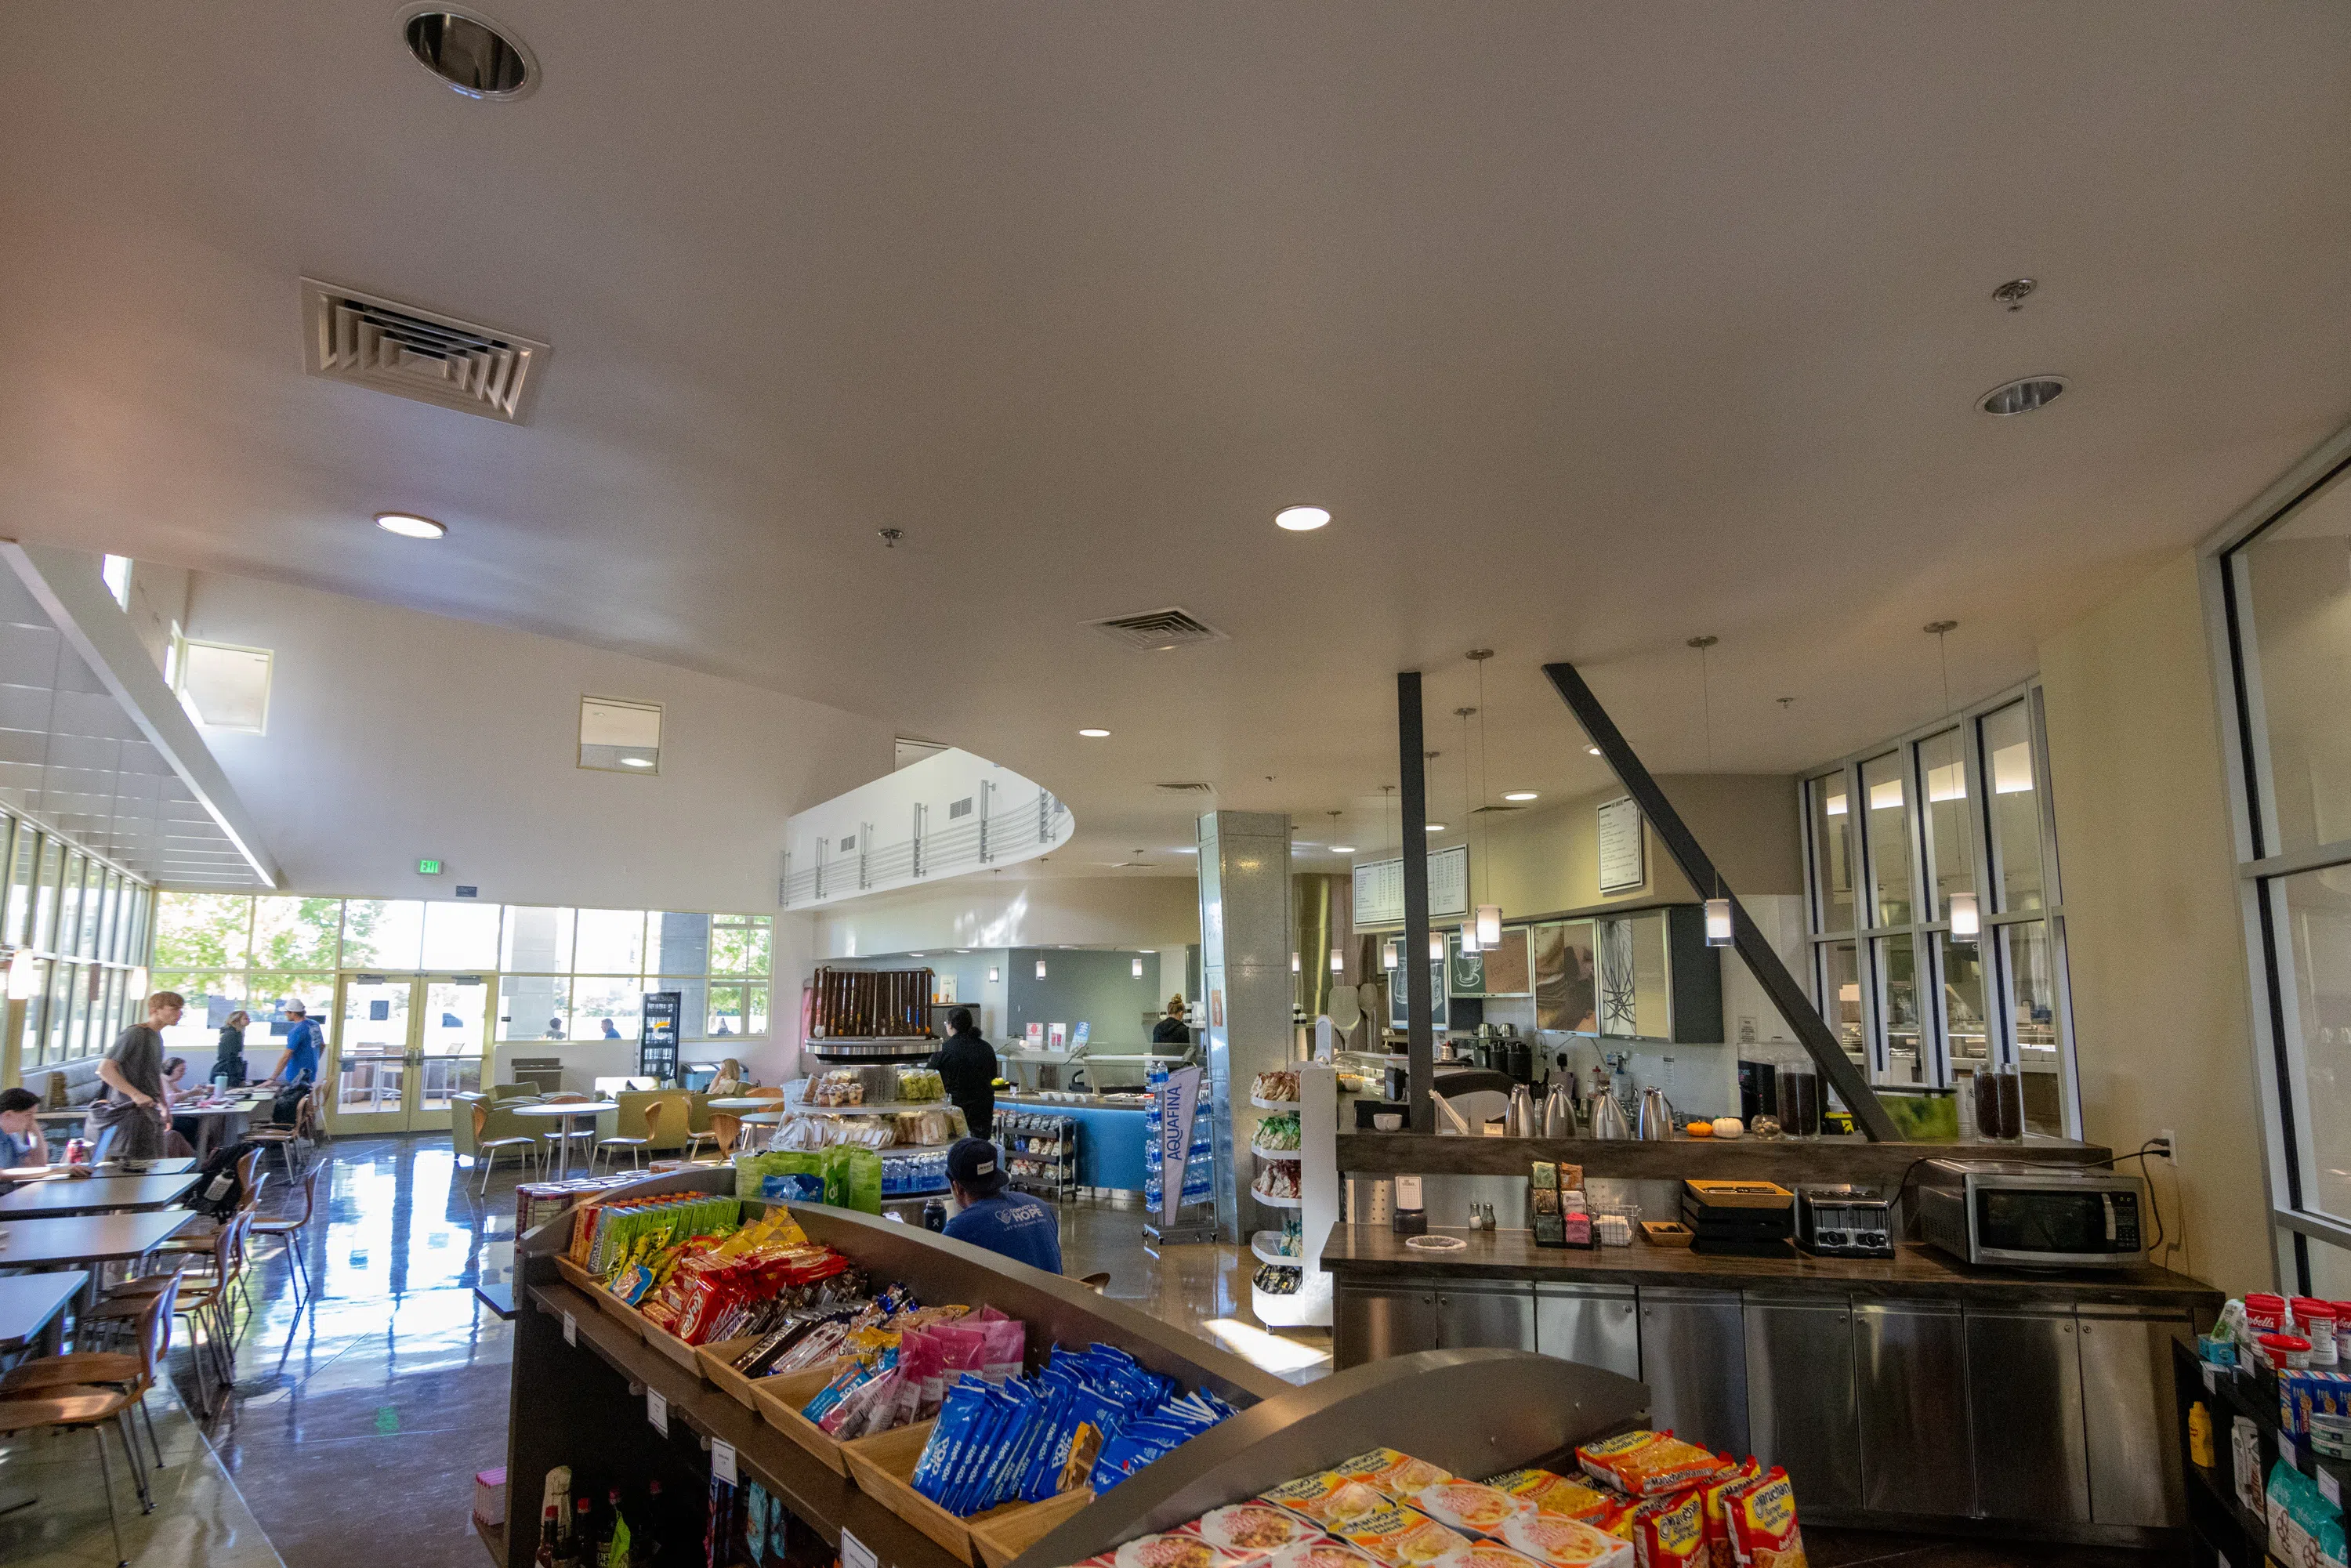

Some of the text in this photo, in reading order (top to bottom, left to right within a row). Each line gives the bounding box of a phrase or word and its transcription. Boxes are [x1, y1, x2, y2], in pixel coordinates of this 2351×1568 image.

[420, 860, 438, 873] EXIT
[1167, 1086, 1183, 1161] AQUAFINA
[1012, 1208, 1044, 1222] HOPE
[1607, 1441, 1631, 1454] Noodle
